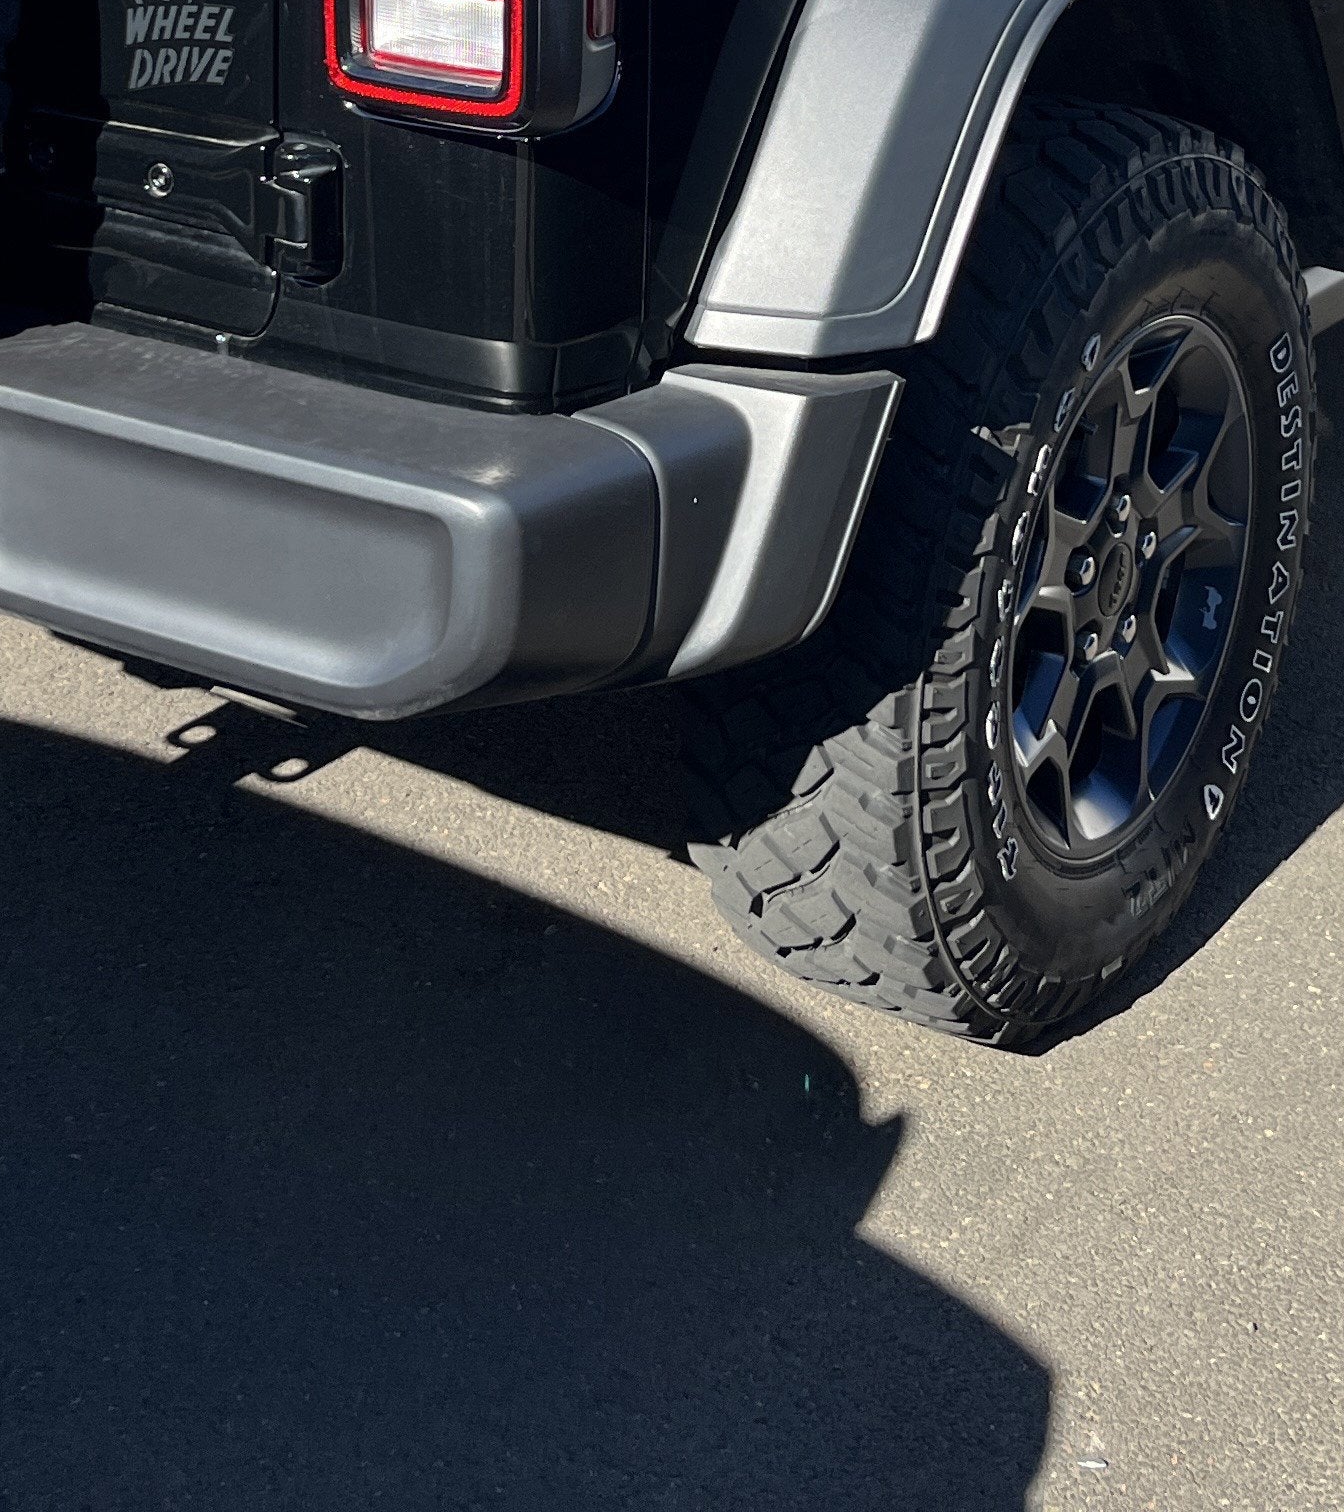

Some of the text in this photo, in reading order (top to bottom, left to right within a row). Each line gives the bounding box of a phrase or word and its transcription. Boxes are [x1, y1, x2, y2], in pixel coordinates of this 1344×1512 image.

[125, 5, 234, 46] WHEEL
[128, 46, 234, 89] DRIVE
[1222, 332, 1303, 774] DESTINATION
